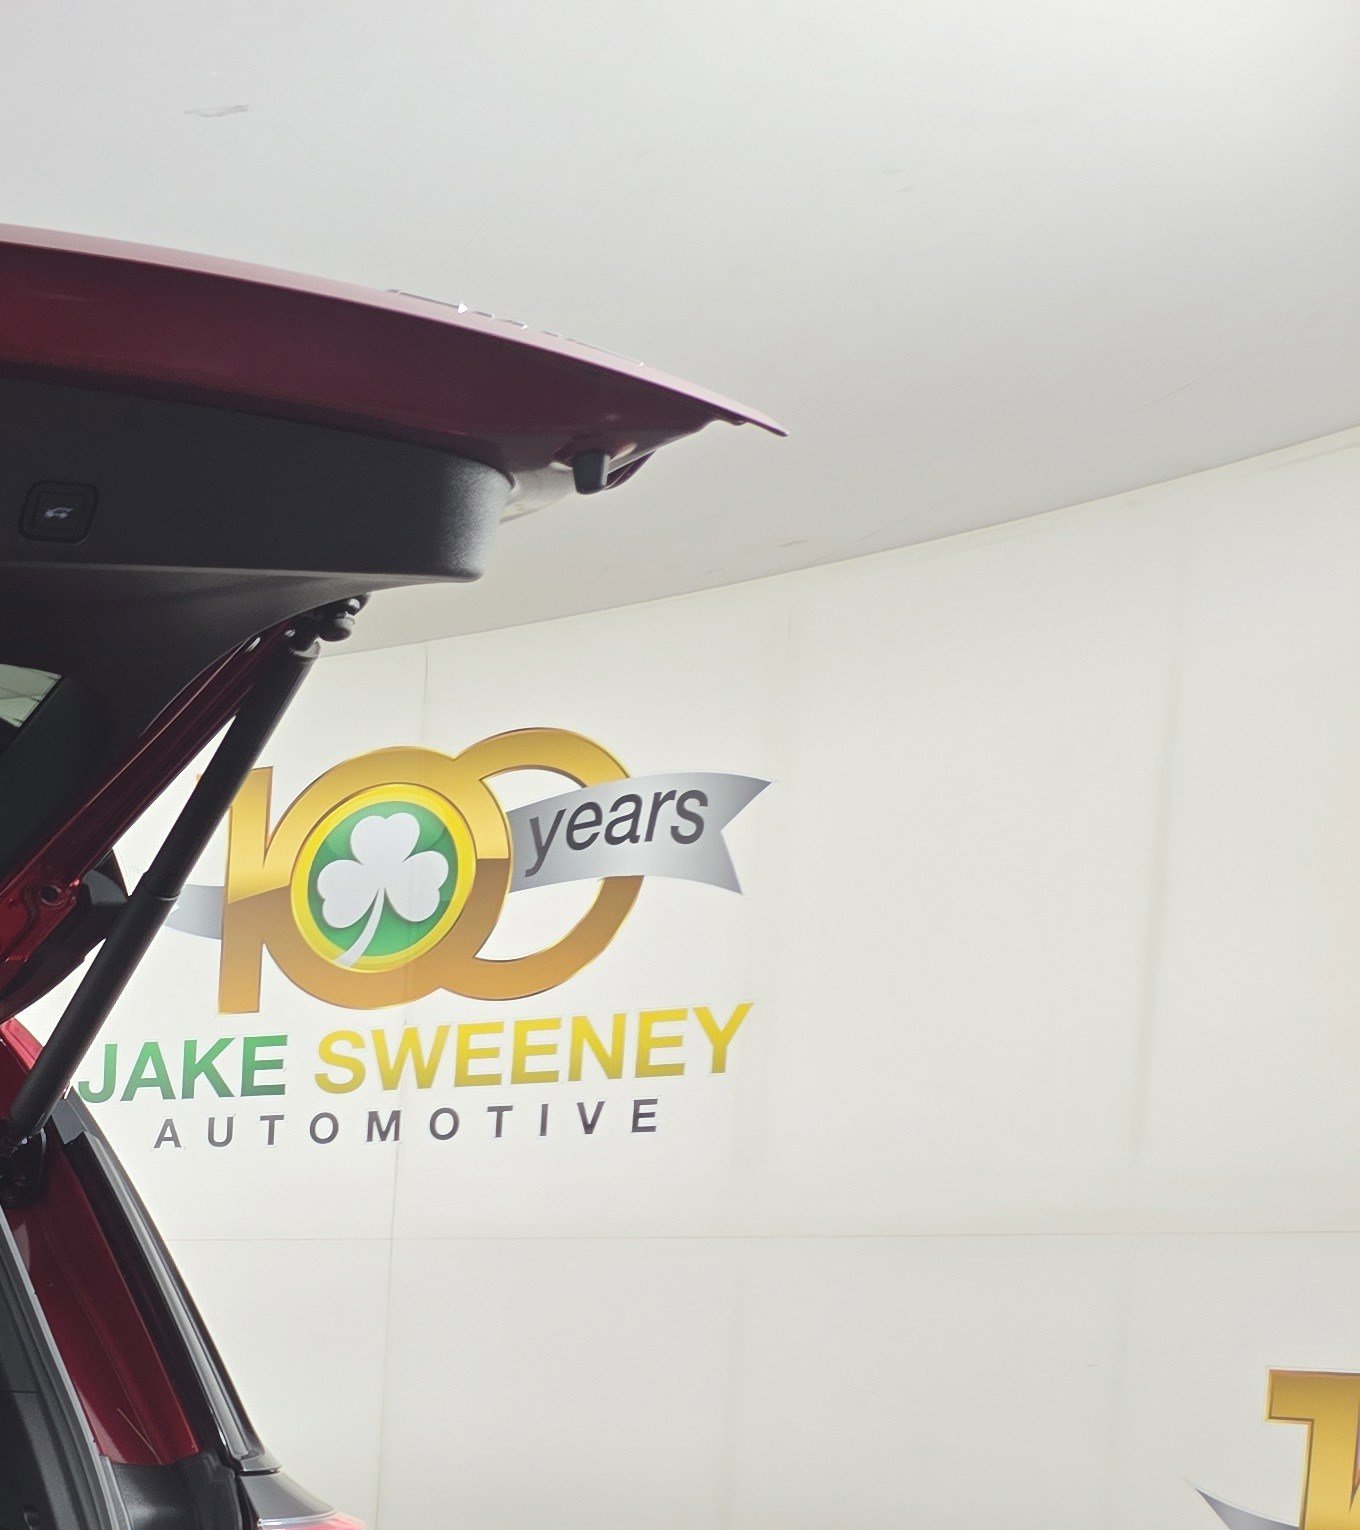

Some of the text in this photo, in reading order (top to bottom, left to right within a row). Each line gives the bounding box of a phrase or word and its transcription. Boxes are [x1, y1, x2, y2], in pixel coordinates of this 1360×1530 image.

[525, 789, 710, 878] years
[78, 1003, 754, 1103] JAKE SWEENEY
[153, 1099, 658, 1149] AUTOMOTIVE
